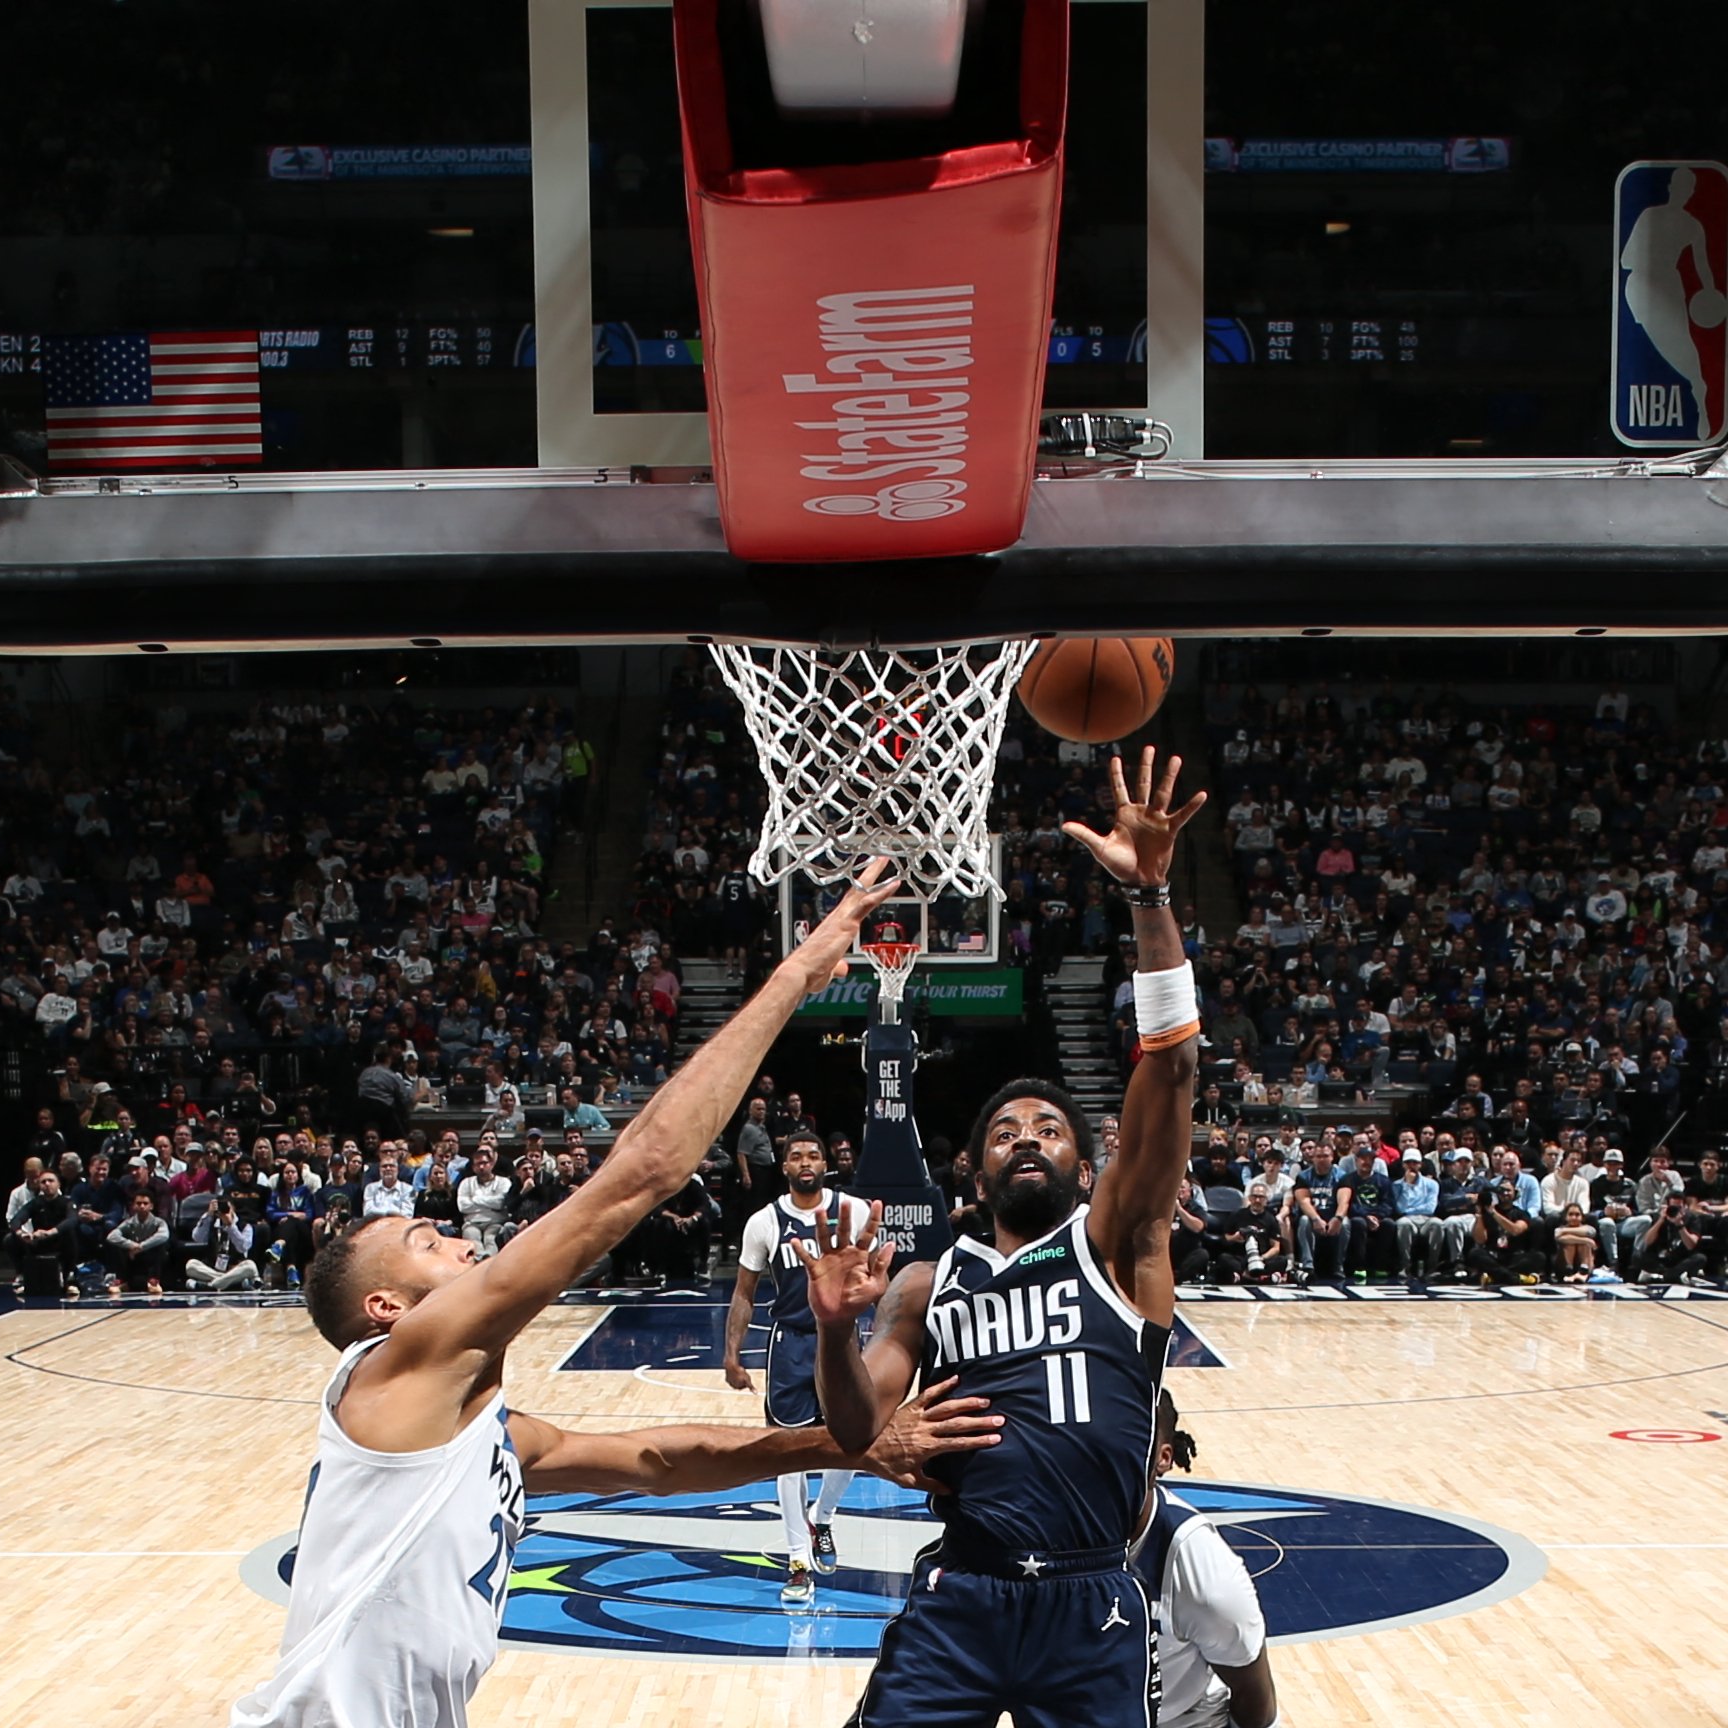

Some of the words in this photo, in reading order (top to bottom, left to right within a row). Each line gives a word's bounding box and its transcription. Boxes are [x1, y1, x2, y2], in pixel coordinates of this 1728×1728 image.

[334, 151, 410, 163] EXCLUSIVE
[412, 150, 468, 163] CASINO
[471, 149, 531, 161] PARTNE
[1241, 142, 1317, 157] EXCLUSIVE
[1319, 142, 1373, 157] CASINO
[1376, 142, 1443, 157] PARTNER
[446, 163, 531, 175] TIMBERWOLVE
[347, 328, 374, 340] REB
[428, 328, 458, 340] FG%
[664, 329, 679, 339] TO
[1088, 325, 1103, 336] TO
[1267, 321, 1295, 333] REB
[1351, 321, 1381, 333] FG%
[260, 331, 284, 348] RTS
[284, 331, 321, 348] RADIO
[348, 342, 374, 354] AST
[429, 340, 458, 352] FT%
[1268, 336, 1294, 347] AST
[1352, 335, 1380, 347] FT%
[665, 343, 676, 359] 6
[1056, 341, 1067, 357] 0
[1091, 341, 1102, 357] 5
[1268, 349, 1294, 361] STL
[1349, 349, 1384, 361] 3PT%
[349, 355, 374, 367] STL
[427, 354, 461, 366] 3PT%
[1628, 384, 1684, 428] NBA
[796, 976, 872, 1011] rite
[960, 984, 1008, 998] THIRST
[878, 1060, 901, 1079] GET
[878, 1080, 901, 1098] THE
[885, 1100, 907, 1122] App
[1019, 1246, 1066, 1266] chime
[927, 1279, 1085, 1369] MAVS
[1041, 1351, 1091, 1425] 11
